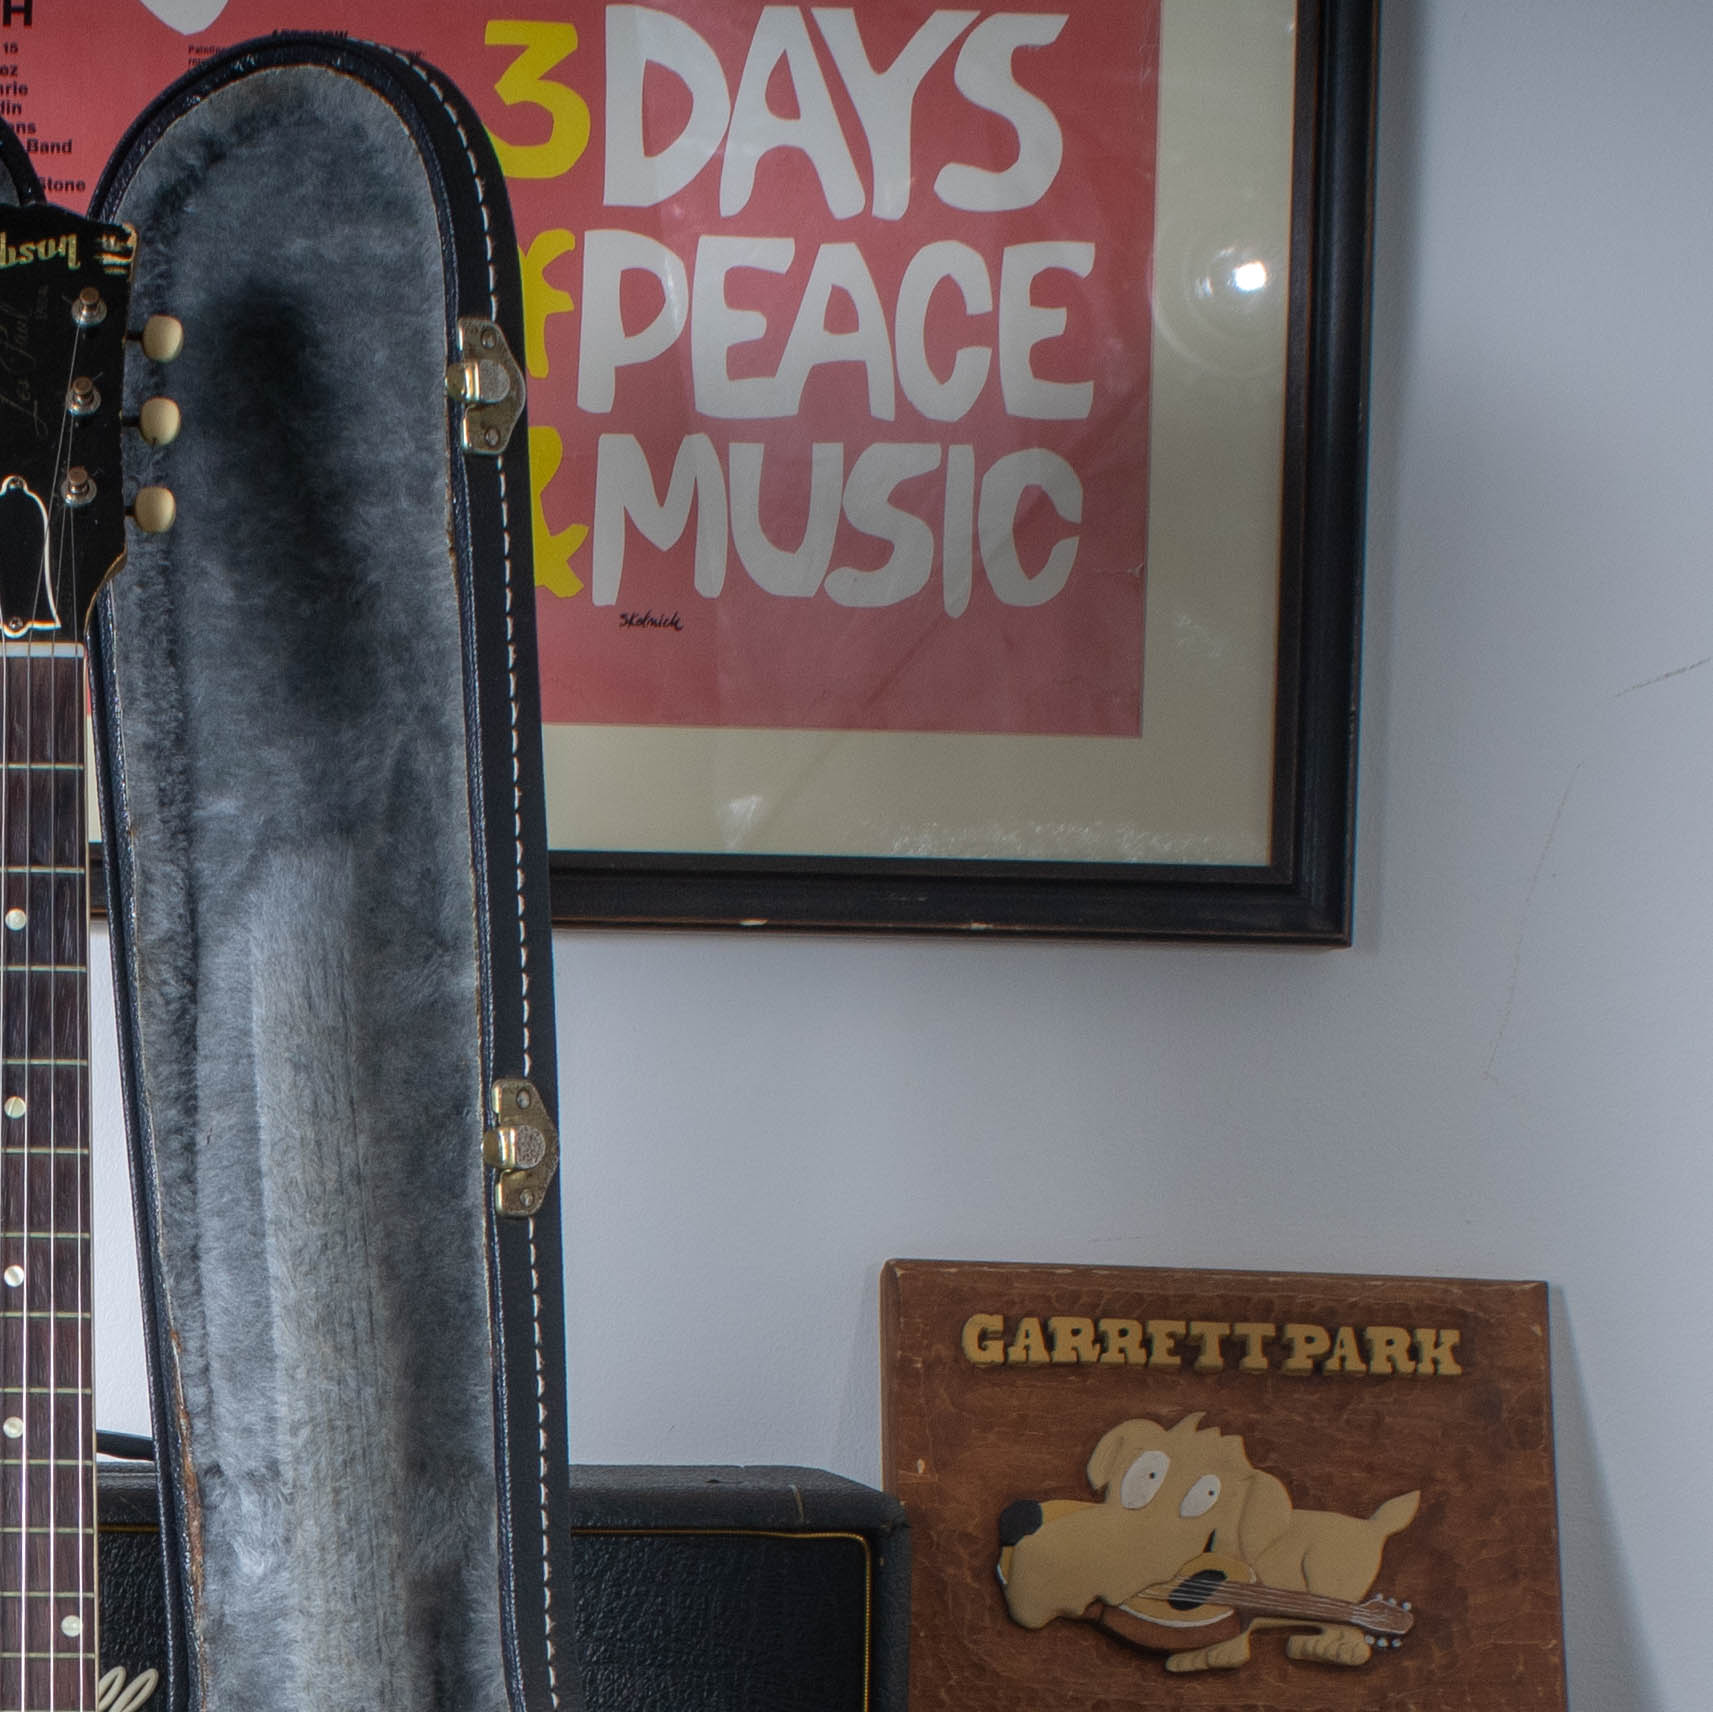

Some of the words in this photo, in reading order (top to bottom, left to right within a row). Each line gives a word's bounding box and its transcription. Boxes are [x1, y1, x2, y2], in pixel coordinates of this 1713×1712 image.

[3, 42, 19, 54] 15
[484, 20, 591, 178] 3
[603, 4, 1068, 220] DAYS
[577, 229, 1095, 421] PEACE
[592, 433, 1083, 619] MUSIC
[960, 1312, 1278, 1369] GARRETT
[1283, 1325, 1463, 1377] PARK
